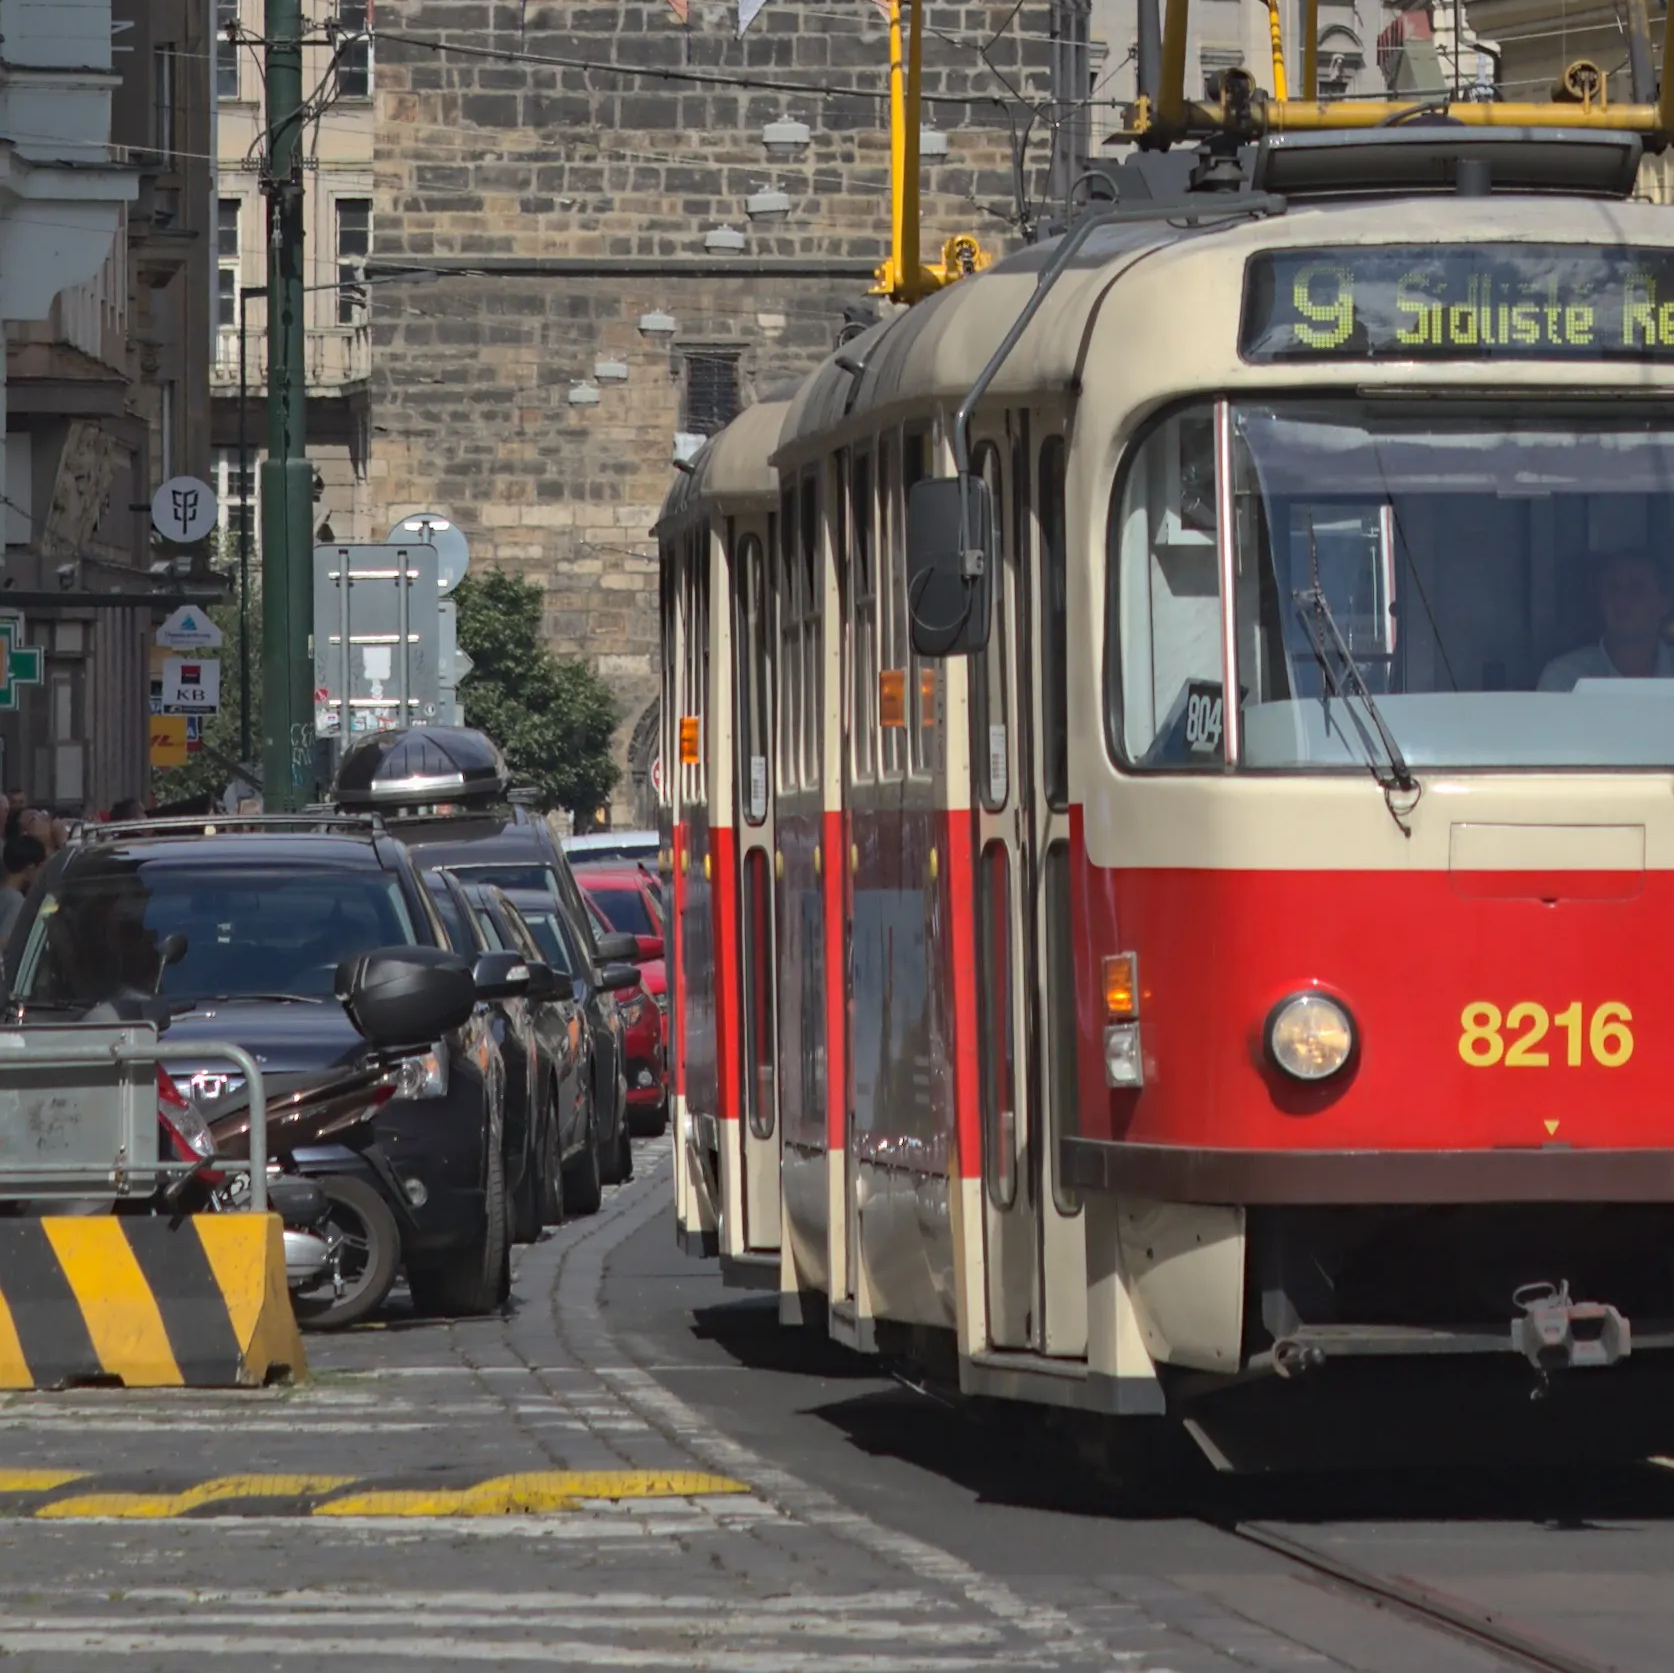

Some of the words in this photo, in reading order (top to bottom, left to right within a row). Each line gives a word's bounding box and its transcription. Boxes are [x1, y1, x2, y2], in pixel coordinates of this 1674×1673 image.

[1293, 266, 1354, 349] 9
[177, 689, 206, 701] KB
[1186, 694, 1222, 746] 804
[1458, 1001, 1634, 1067] 8216
